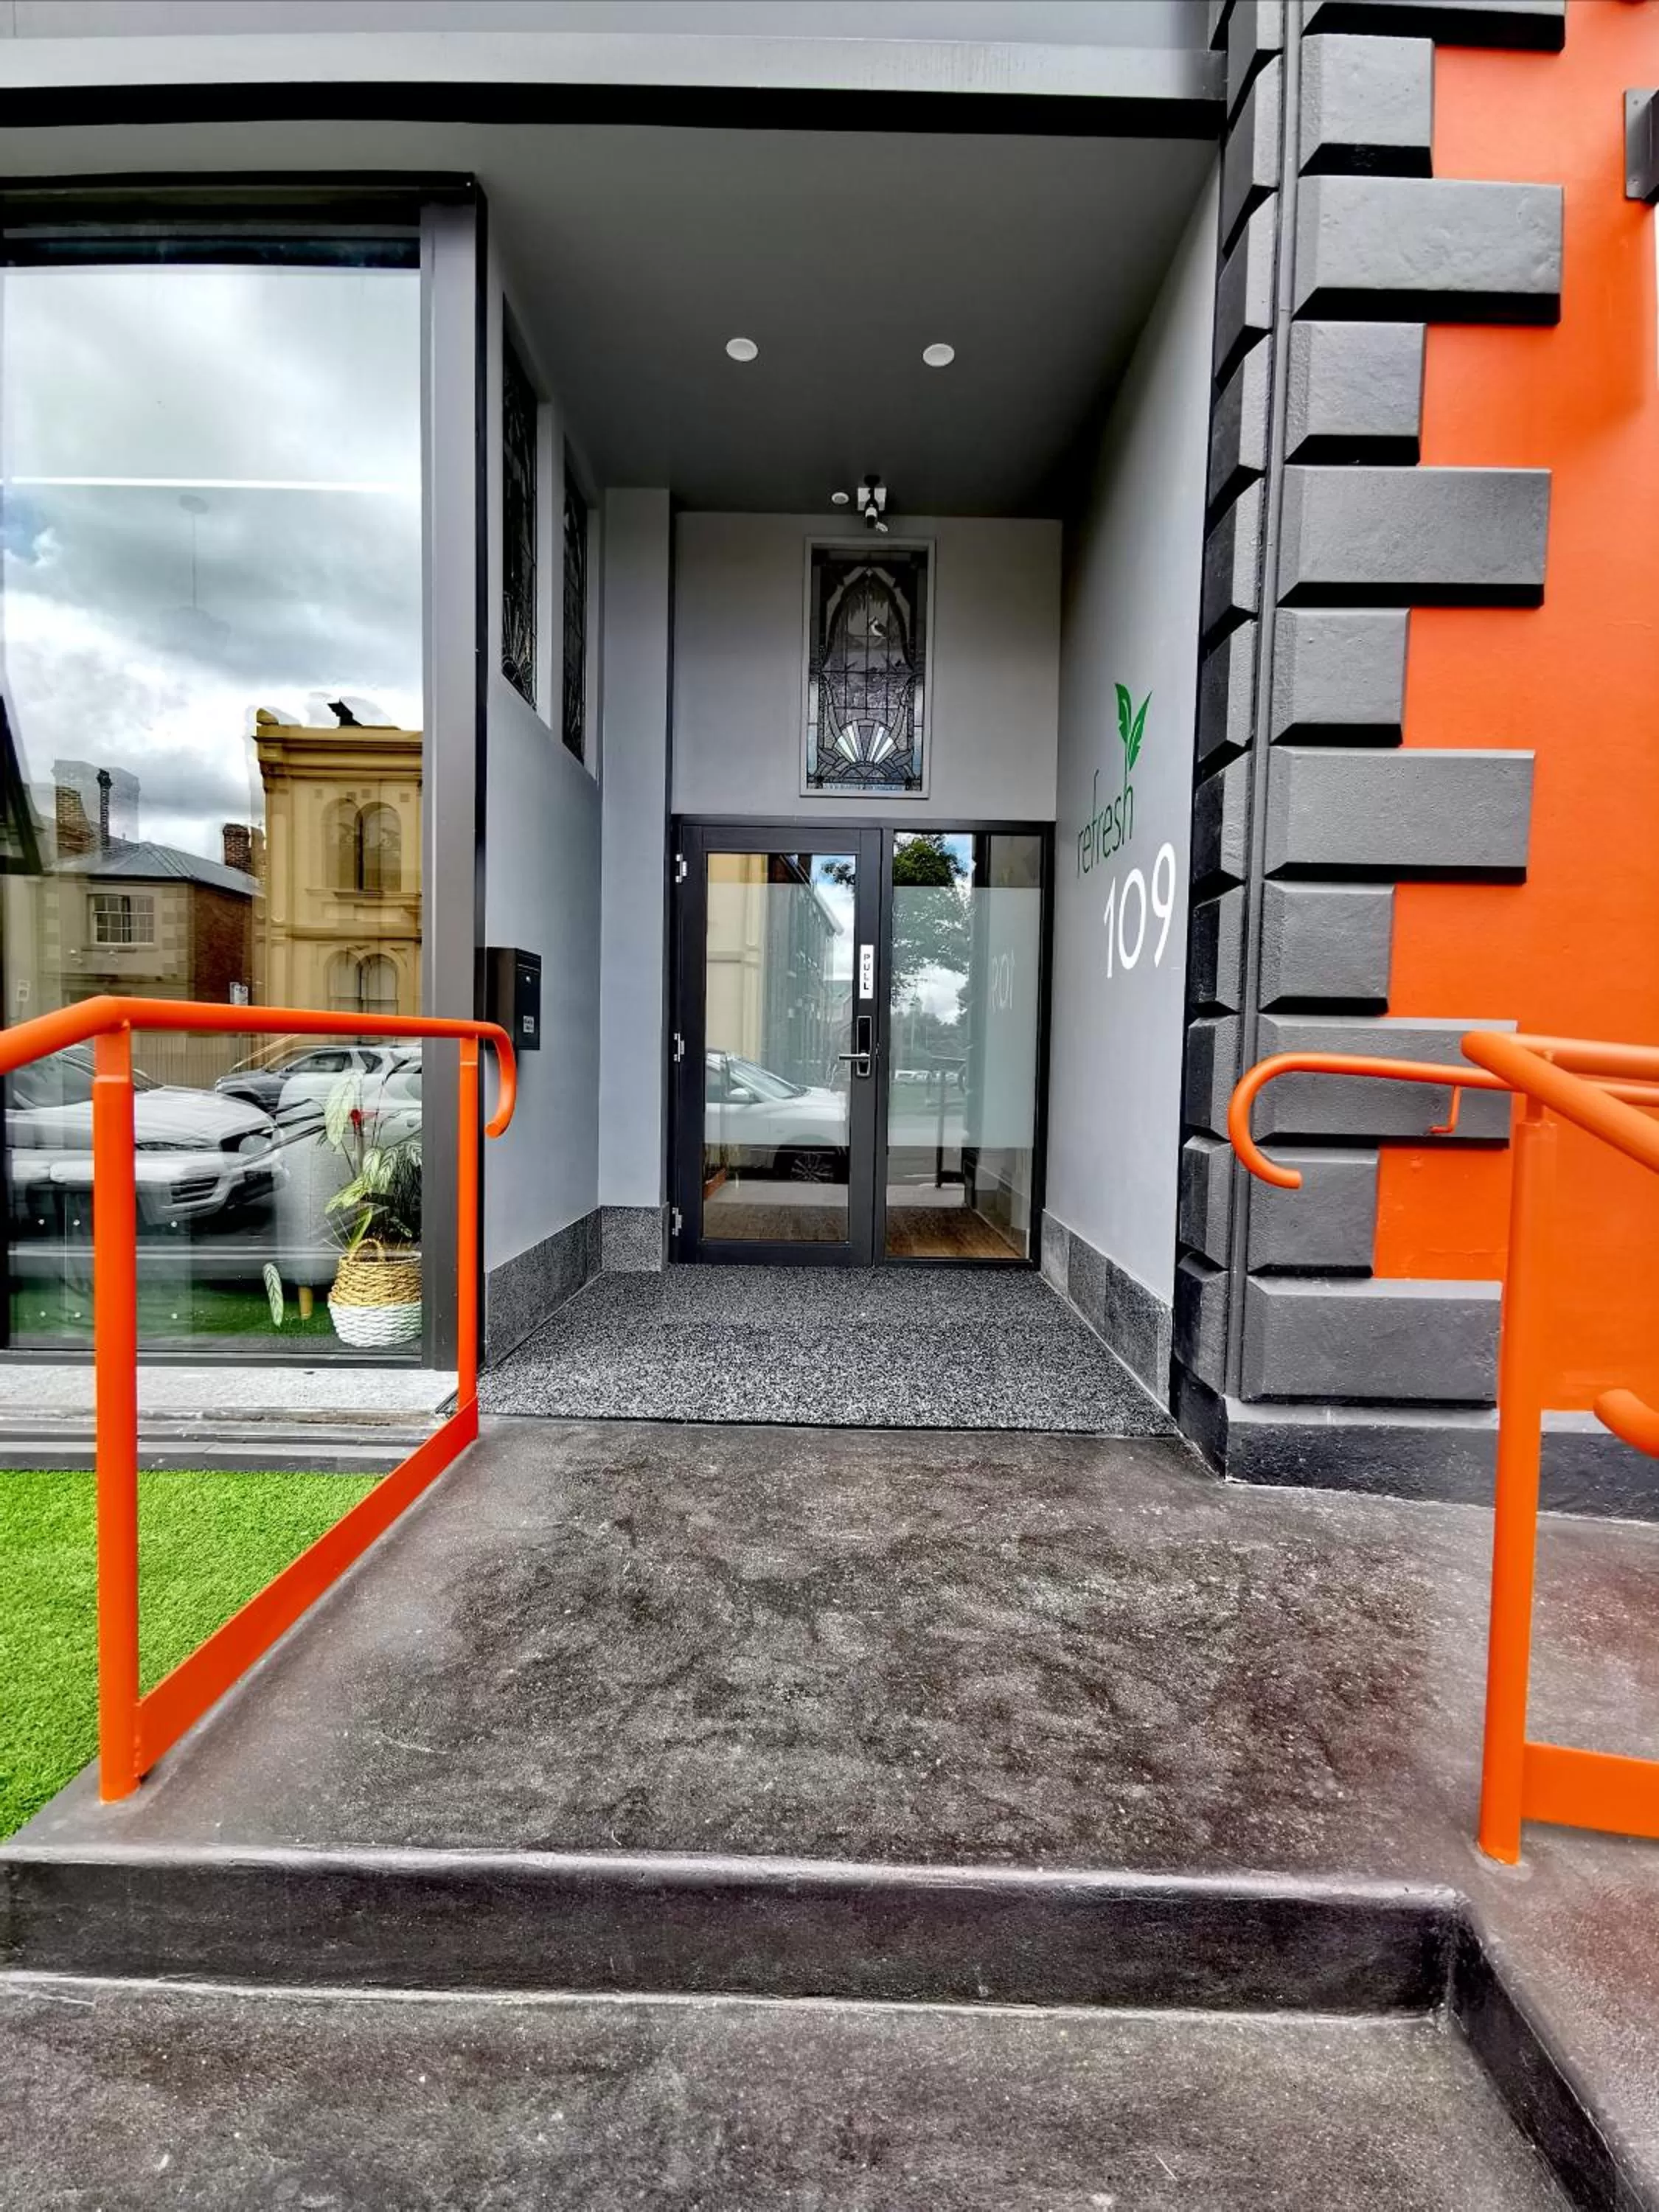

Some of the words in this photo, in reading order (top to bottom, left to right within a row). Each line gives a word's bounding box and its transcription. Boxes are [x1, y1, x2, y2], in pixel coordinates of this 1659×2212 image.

[1077, 763, 1134, 880] refresh
[1103, 841, 1176, 979] 109
[863, 953, 871, 990] PULL
